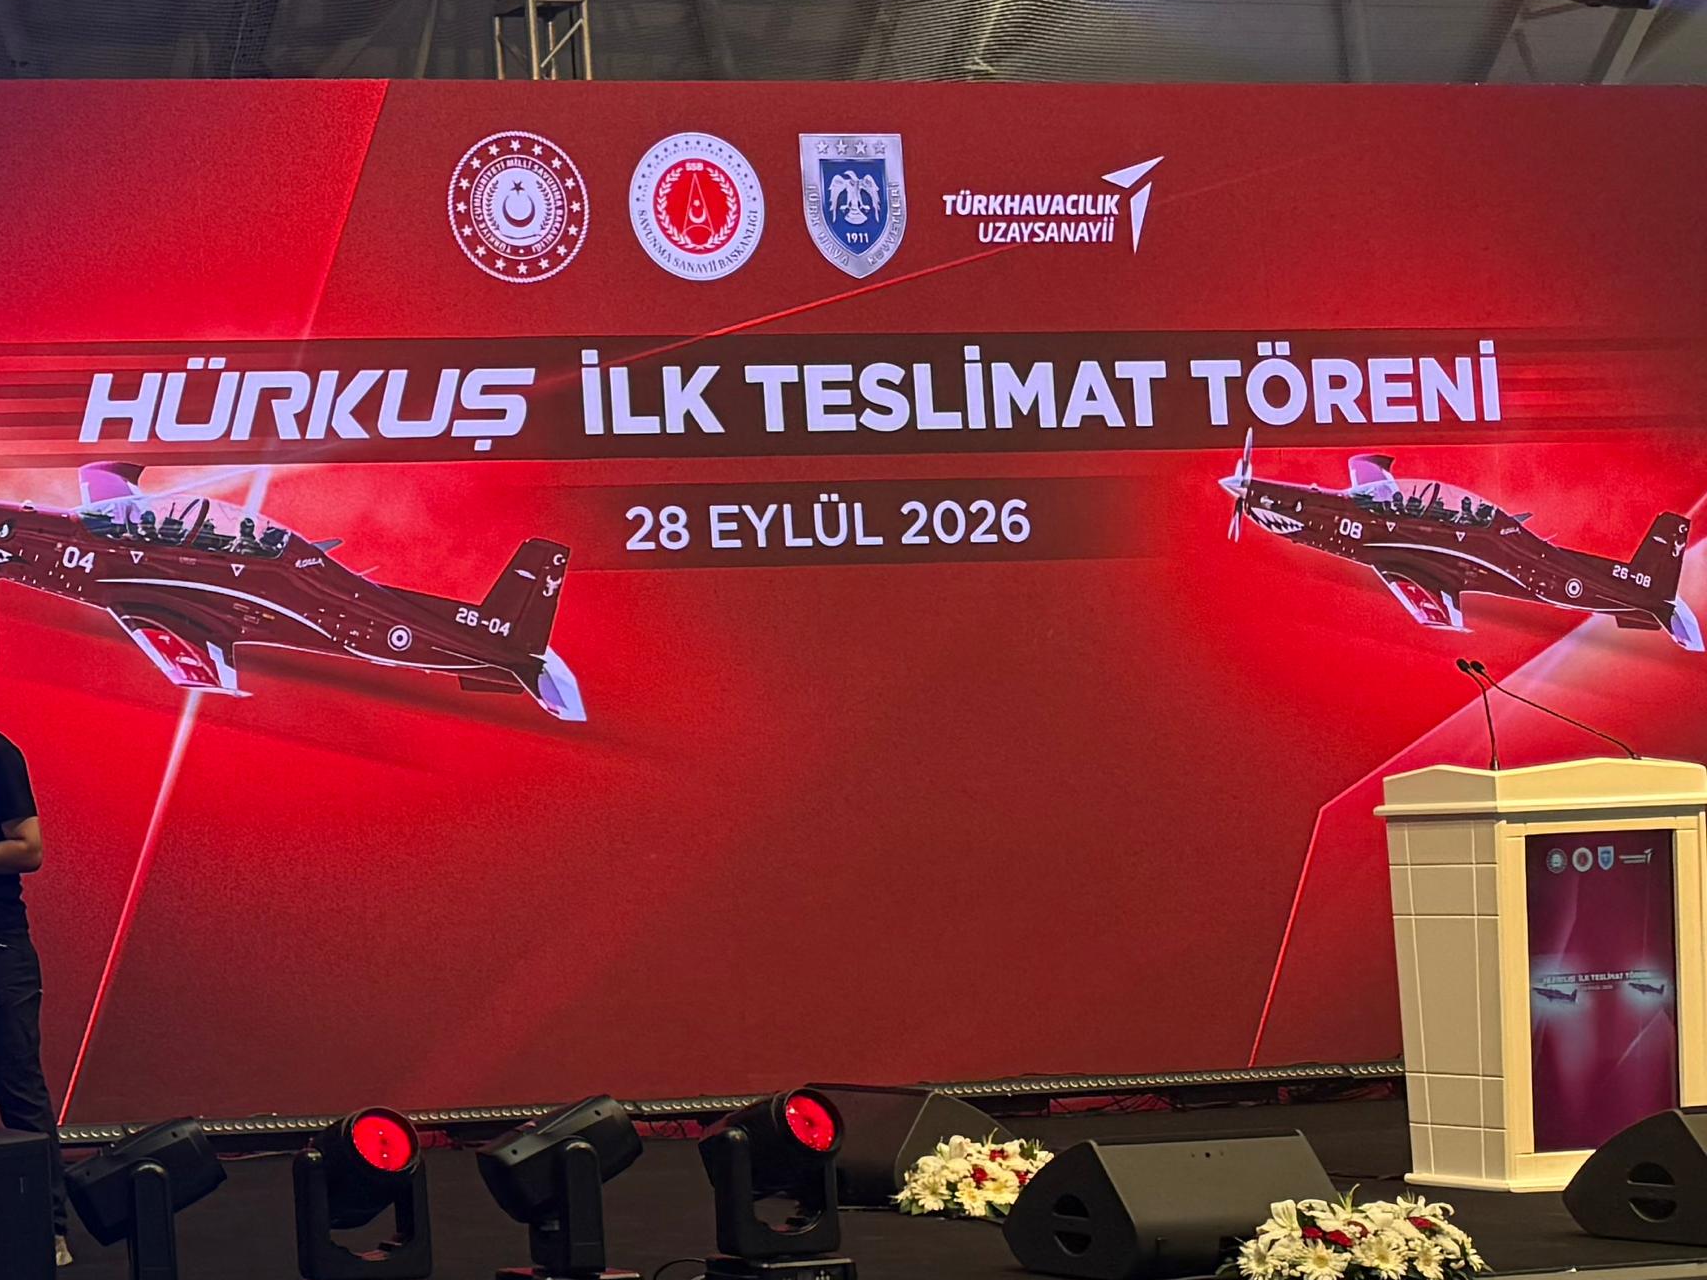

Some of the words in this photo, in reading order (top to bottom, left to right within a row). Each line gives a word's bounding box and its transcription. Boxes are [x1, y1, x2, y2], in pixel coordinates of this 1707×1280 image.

[942, 190, 1120, 216] TÜRKHAVACILIK
[846, 232, 869, 243] 1911
[78, 357, 536, 451] HÜRKUŞ
[581, 349, 725, 435] İLK
[744, 345, 1167, 433] TESLİMAT
[1190, 340, 1502, 426] TÖRENİ
[625, 505, 690, 551] 28
[709, 493, 884, 549] EYLÜL
[901, 499, 1031, 545] 2026
[1339, 518, 1363, 539] 08
[62, 546, 95, 574] 04
[1612, 564, 1651, 588] 26-08
[455, 607, 511, 637] 26-04
